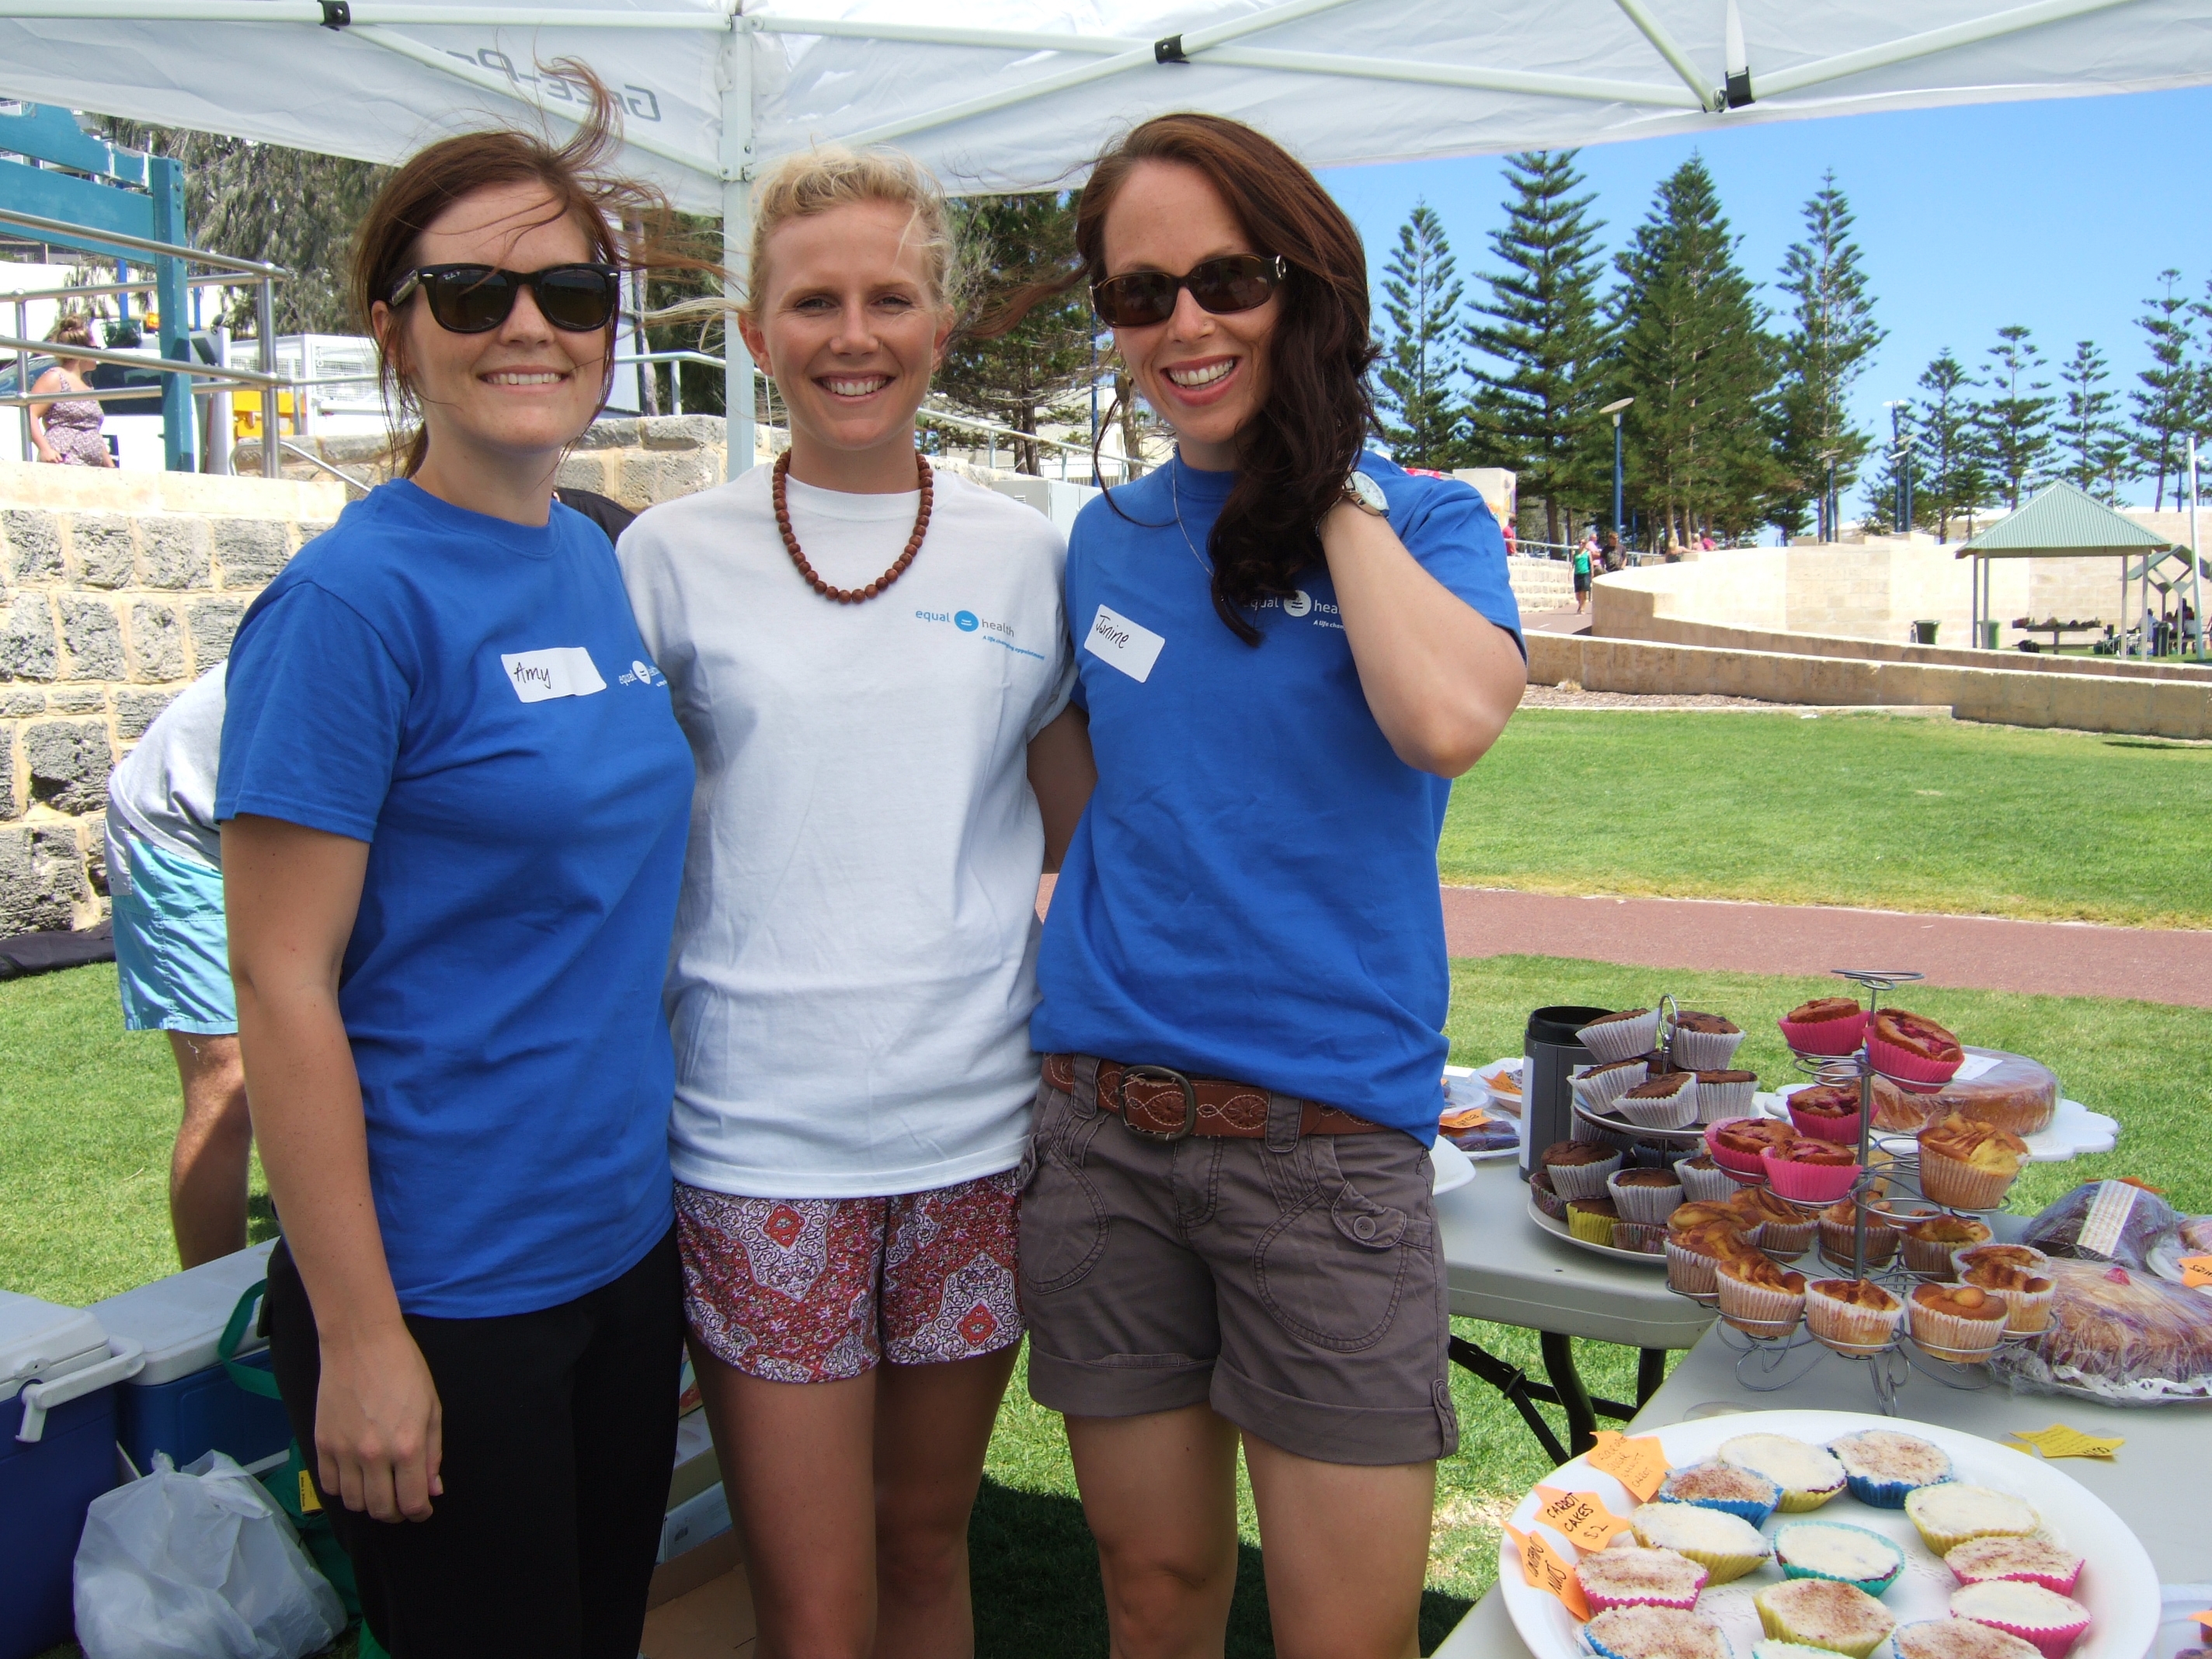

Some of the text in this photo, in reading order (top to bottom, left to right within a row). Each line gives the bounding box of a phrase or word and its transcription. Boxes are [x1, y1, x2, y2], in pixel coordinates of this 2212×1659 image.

[1243, 596, 1341, 614] qual hea
[915, 610, 1015, 637] equal health
[1096, 614, 1129, 649] Janine
[513, 662, 551, 690] Amy
[1546, 1492, 1580, 1518] CARROT
[1564, 1503, 1594, 1532] CAKES
[1545, 1560, 1567, 1595] NUTS
